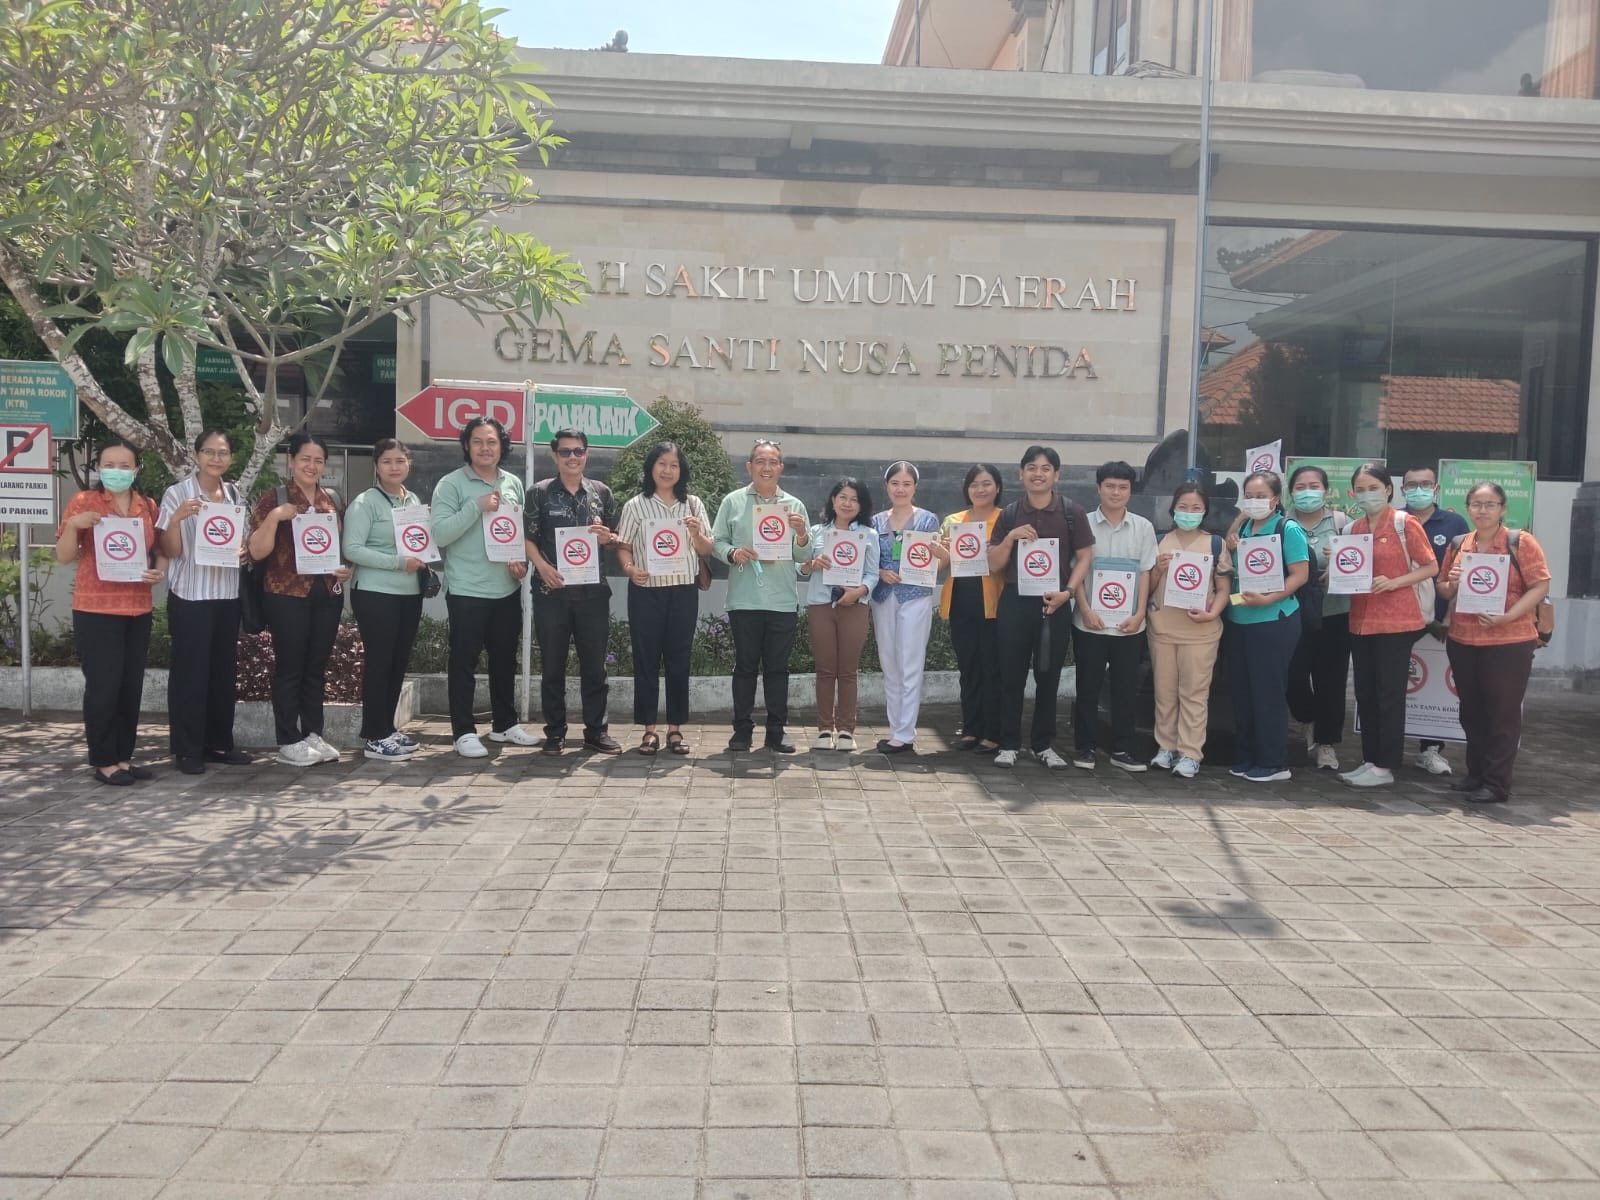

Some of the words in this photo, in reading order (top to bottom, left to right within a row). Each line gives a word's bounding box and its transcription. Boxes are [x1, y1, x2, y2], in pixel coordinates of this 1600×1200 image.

[645, 262, 776, 301] SAKIT
[790, 267, 937, 306] UMUM
[954, 272, 1137, 312] DAERAH
[494, 326, 632, 366] GEMA
[648, 332, 782, 371] SANTI
[799, 338, 921, 376] NUSA
[936, 341, 1099, 379] PENIDA
[36, 376, 57, 386] PADA
[10, 387, 36, 397] TANPA
[38, 388, 67, 399] ROKOK
[5, 399, 28, 410] (KTR)
[433, 397, 516, 435] IGD
[9, 507, 49, 516] PARKING
